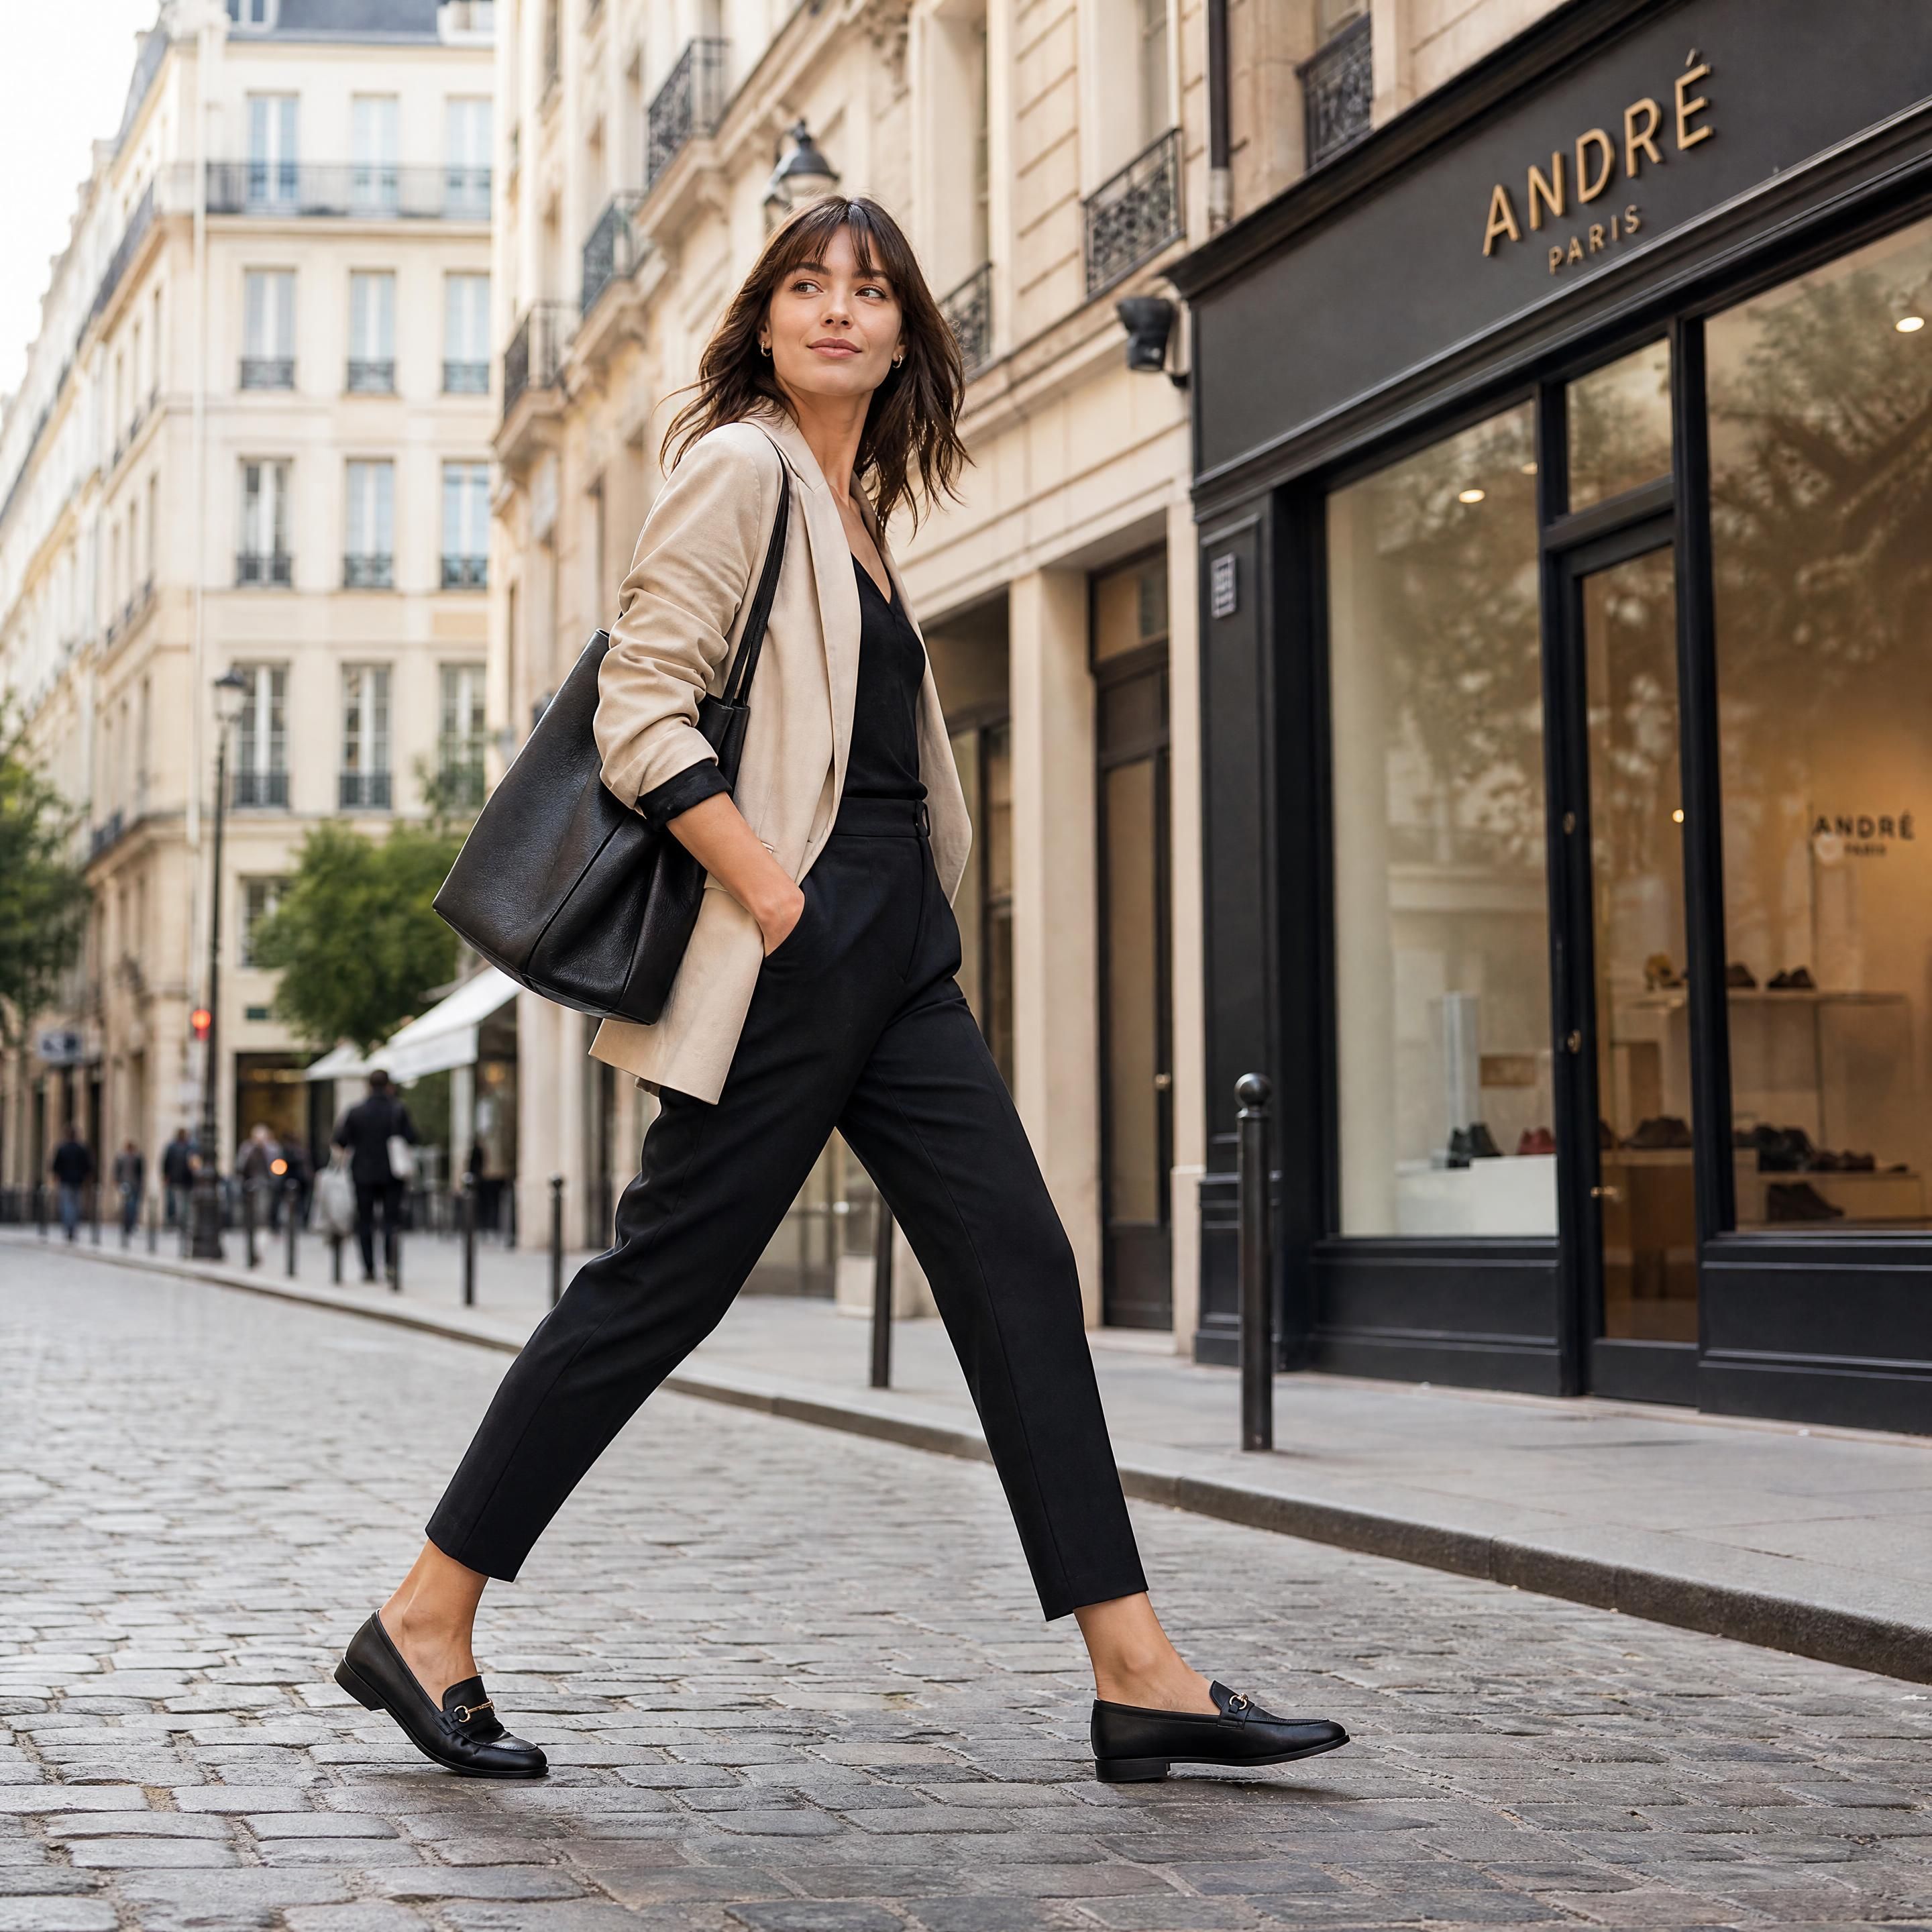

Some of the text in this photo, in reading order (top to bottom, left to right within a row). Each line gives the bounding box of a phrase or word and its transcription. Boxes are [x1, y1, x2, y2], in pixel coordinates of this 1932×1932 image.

[1483, 48, 1715, 256] ANDRÉ
[1549, 205, 1641, 274] PARIS
[1812, 810, 1915, 840] ANDRÉ
